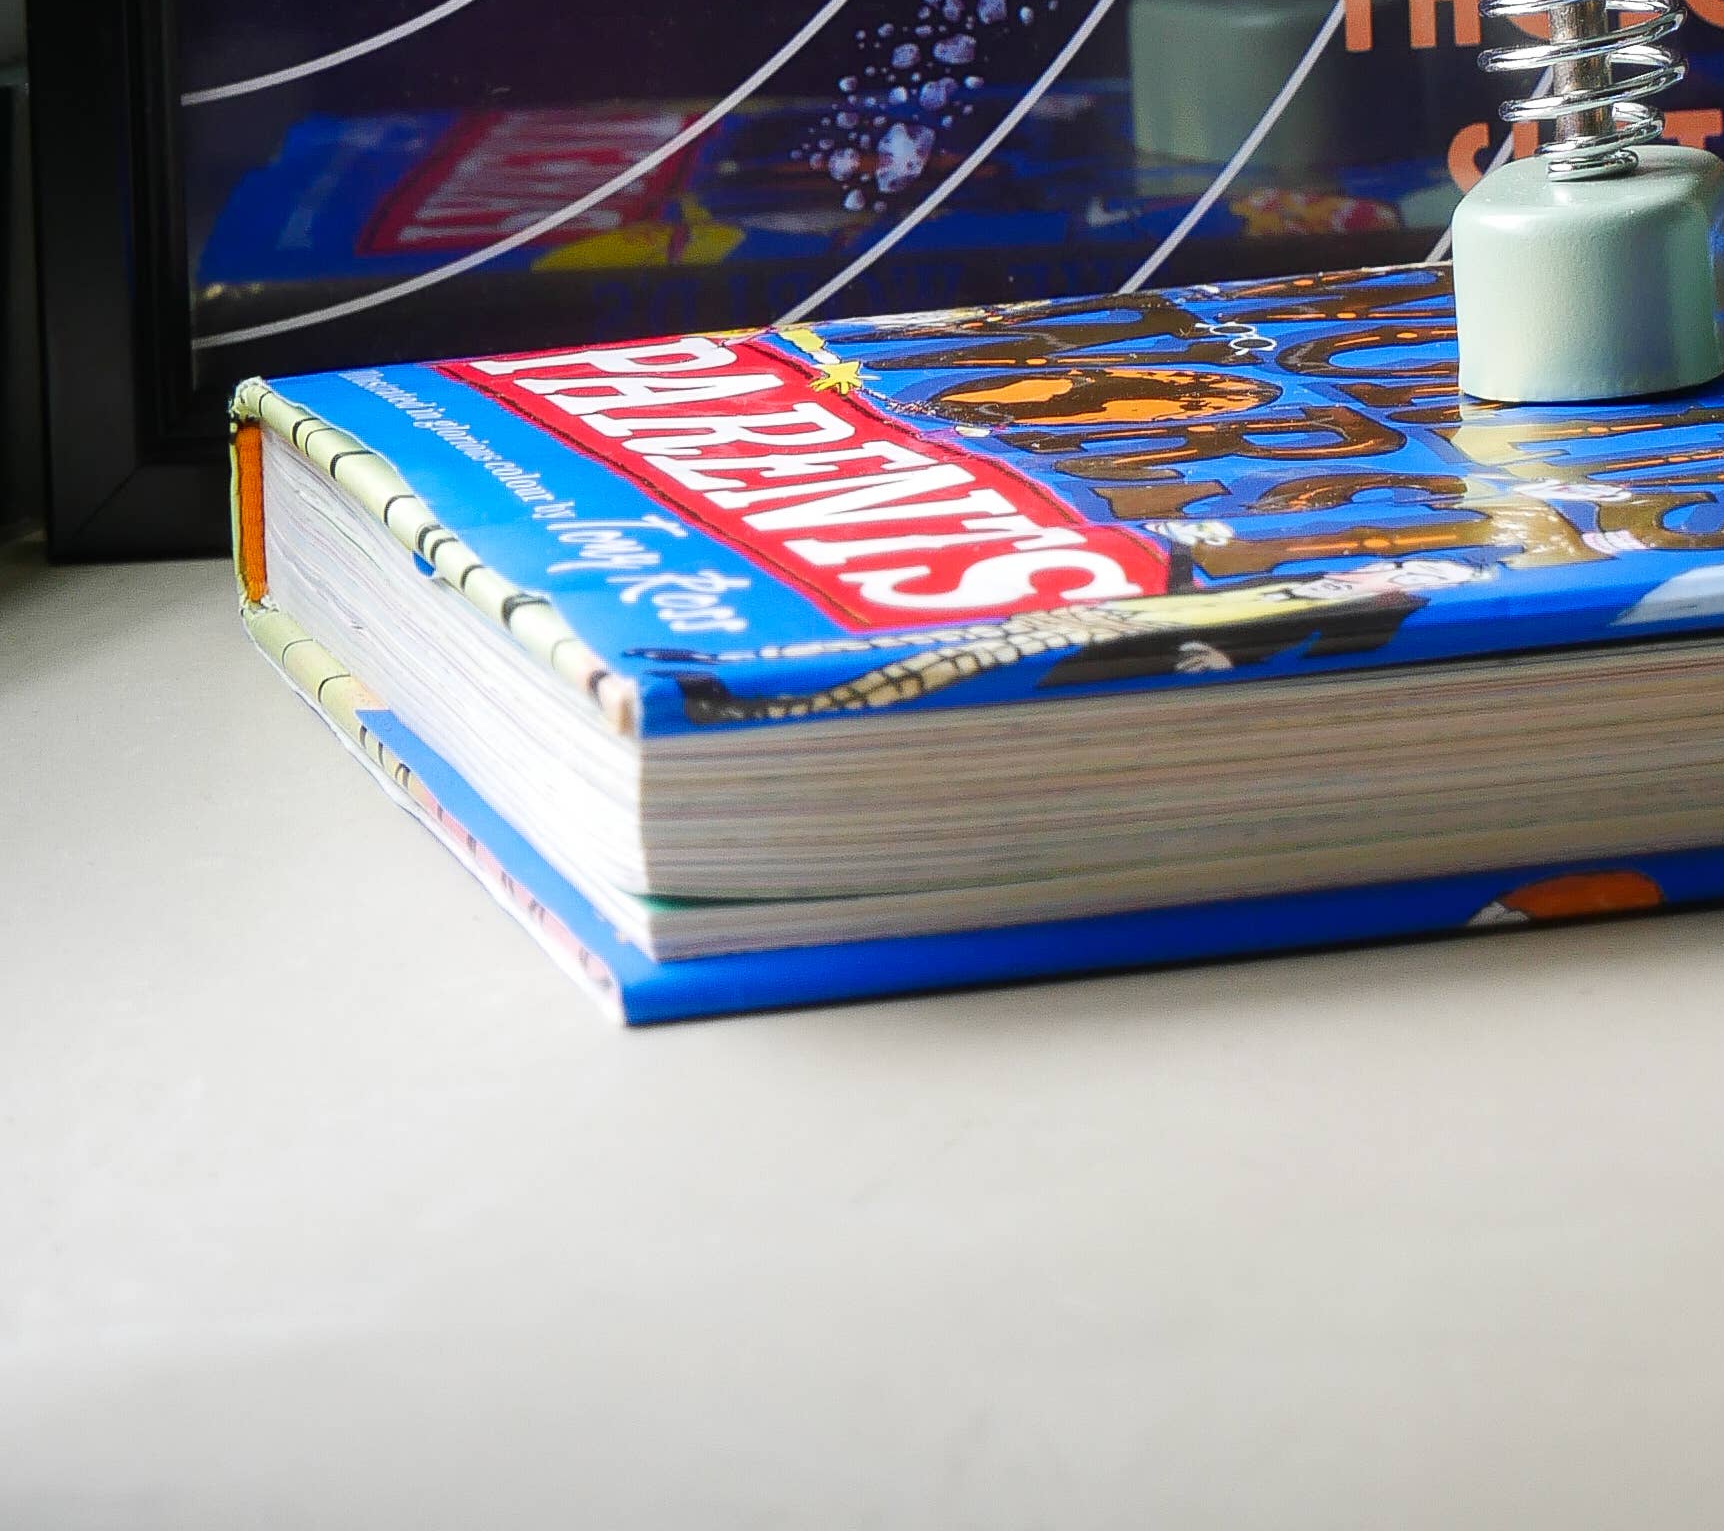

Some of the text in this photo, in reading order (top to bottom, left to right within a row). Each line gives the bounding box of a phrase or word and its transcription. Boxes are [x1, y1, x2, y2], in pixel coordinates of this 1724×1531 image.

[412, 419, 503, 462] glorious
[468, 336, 1144, 609] PARENTS
[483, 458, 555, 504] colour
[531, 500, 577, 520] by
[546, 514, 689, 574] Tony
[605, 565, 752, 633] Ross
